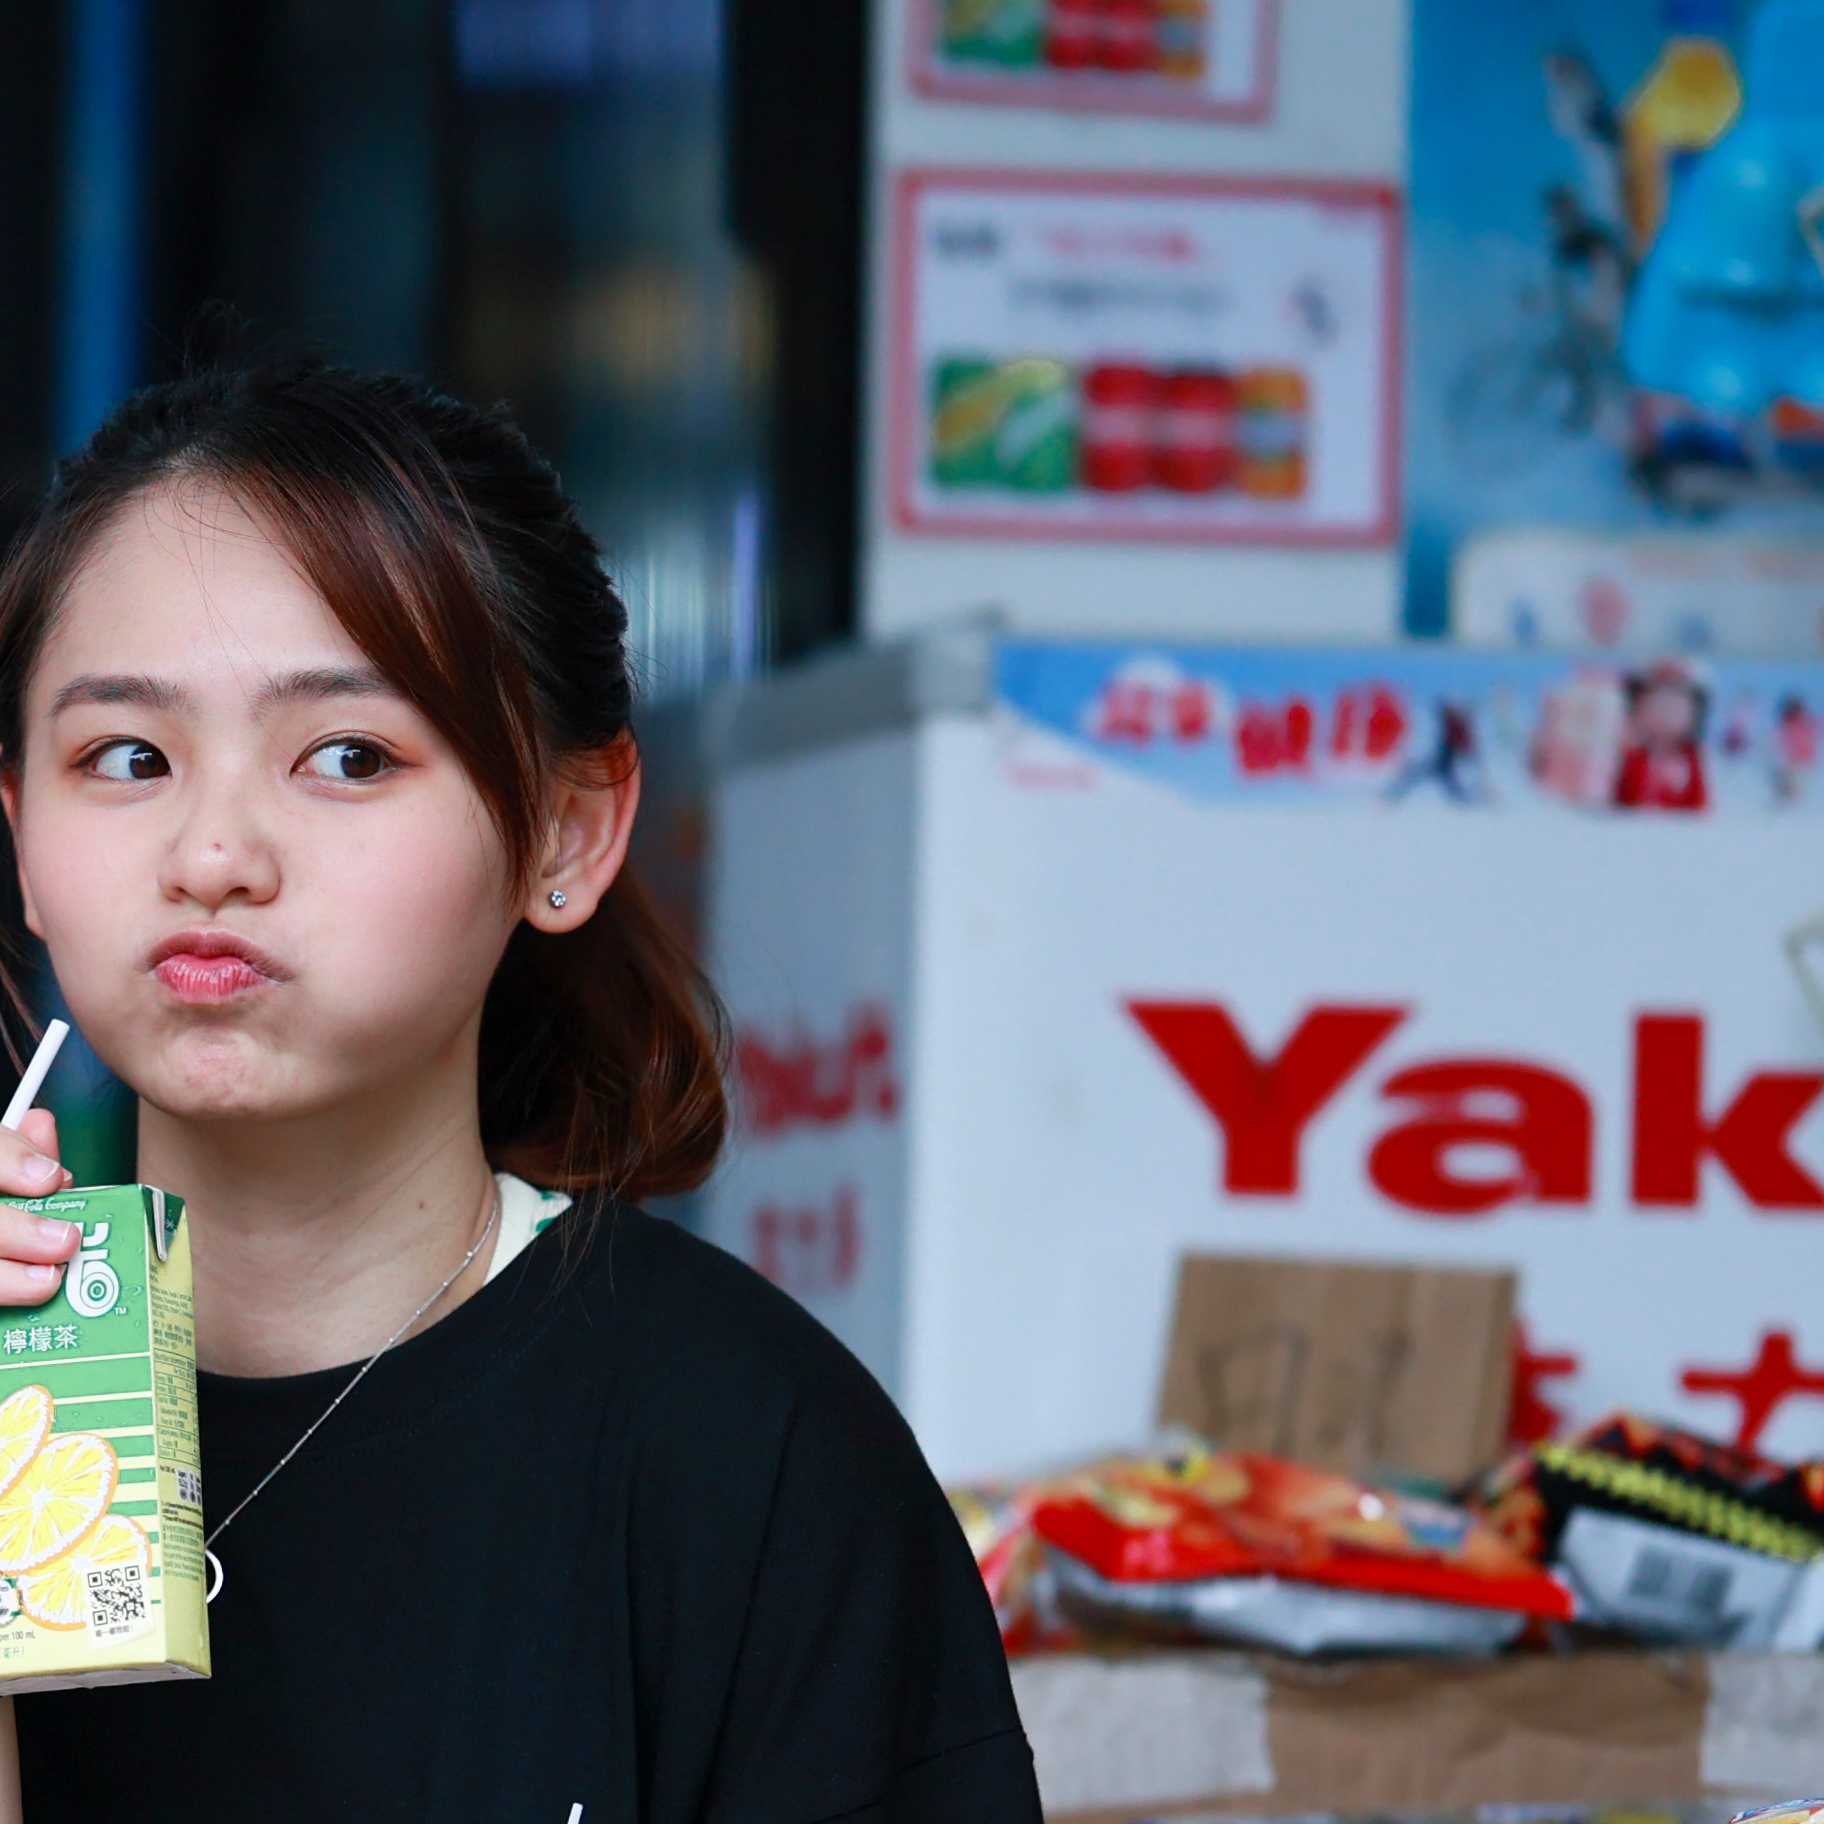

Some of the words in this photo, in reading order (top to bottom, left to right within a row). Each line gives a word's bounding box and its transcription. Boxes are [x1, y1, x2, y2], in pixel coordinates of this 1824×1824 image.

[3, 1323, 78, 1355] 檸檬茶
[0, 1633, 10, 1643] per
[11, 1631, 24, 1640] 100
[25, 1630, 36, 1639] mL
